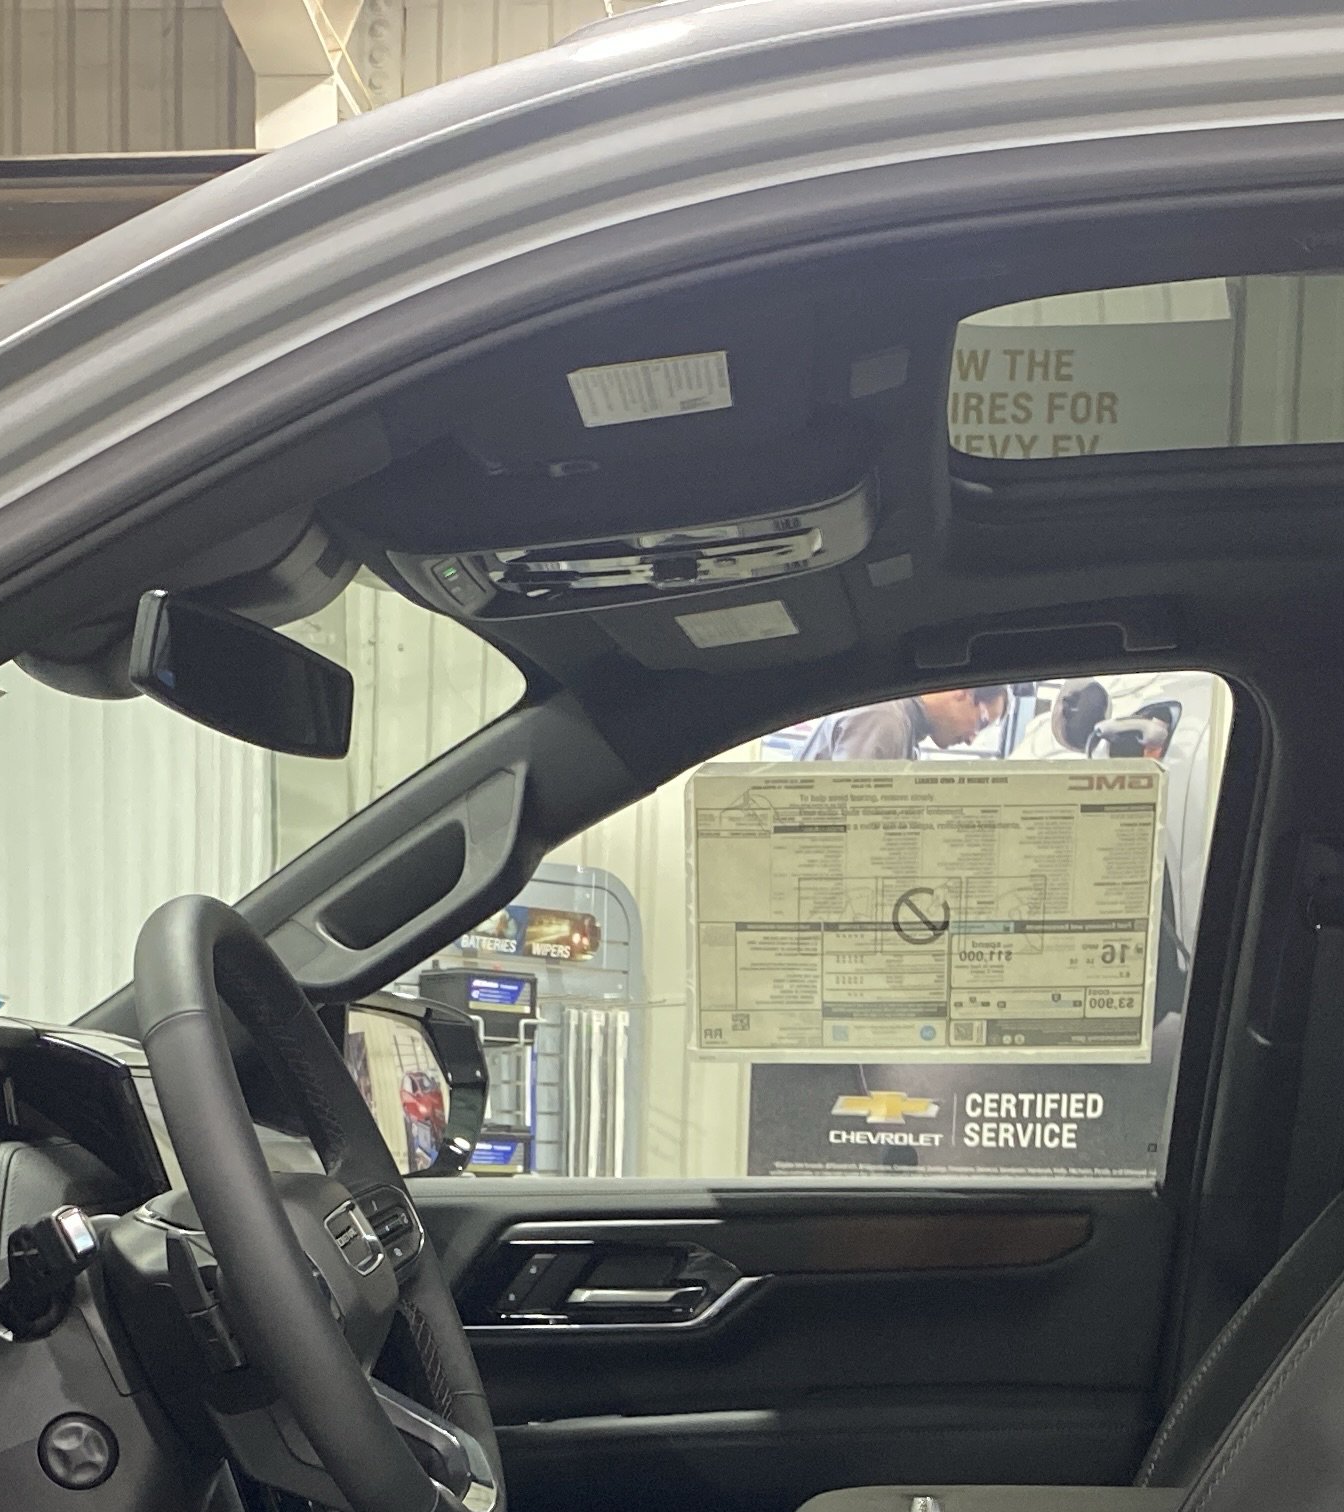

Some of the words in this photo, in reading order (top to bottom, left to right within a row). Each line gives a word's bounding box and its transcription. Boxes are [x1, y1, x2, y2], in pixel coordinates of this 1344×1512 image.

[1002, 349, 1075, 382] THE
[1046, 391, 1120, 425] FOR
[460, 934, 518, 953] BATTERIES
[531, 942, 571, 959] WIPERS
[964, 1092, 1105, 1119] CERTIFIED
[828, 1129, 944, 1147] CHEVROLET
[963, 1122, 1078, 1149] SERVICE
